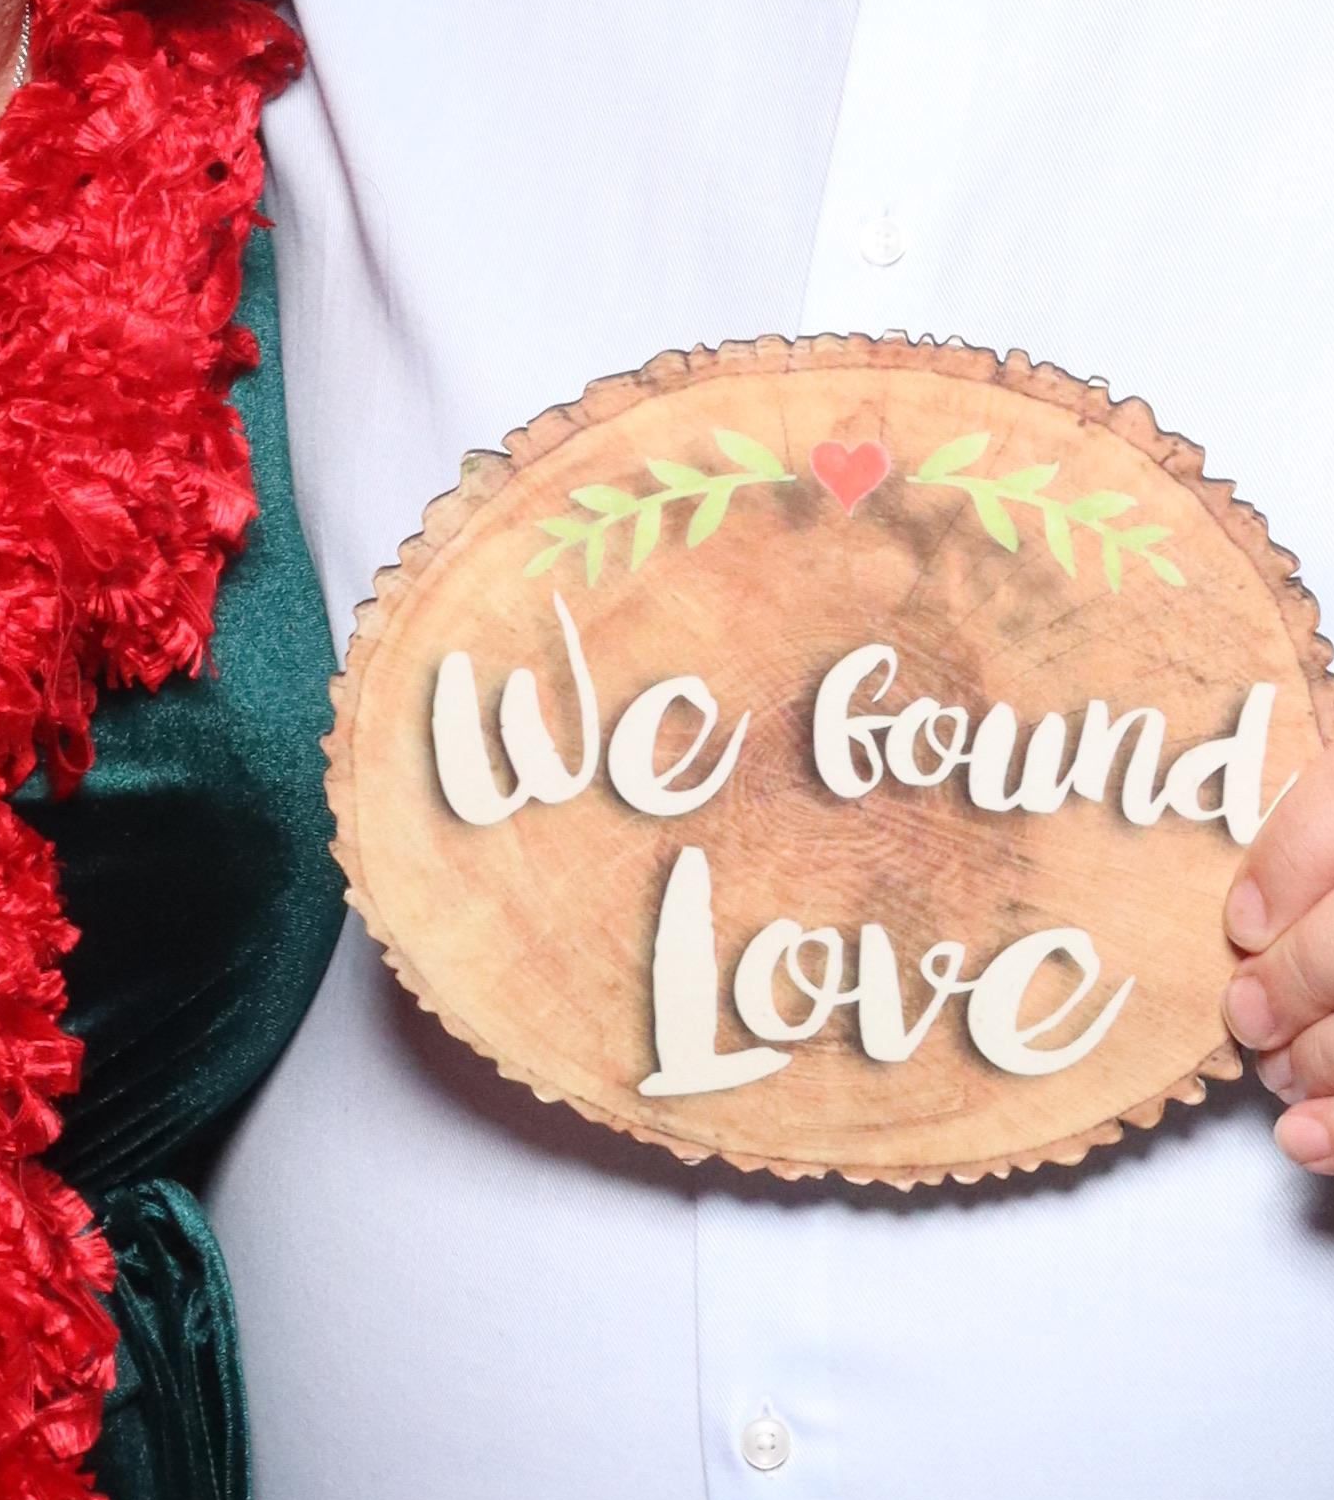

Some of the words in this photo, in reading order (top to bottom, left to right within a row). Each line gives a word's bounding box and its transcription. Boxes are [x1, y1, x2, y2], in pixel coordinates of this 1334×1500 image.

[431, 590, 753, 826] We
[812, 644, 1299, 845] found
[637, 846, 1135, 1097] Love
